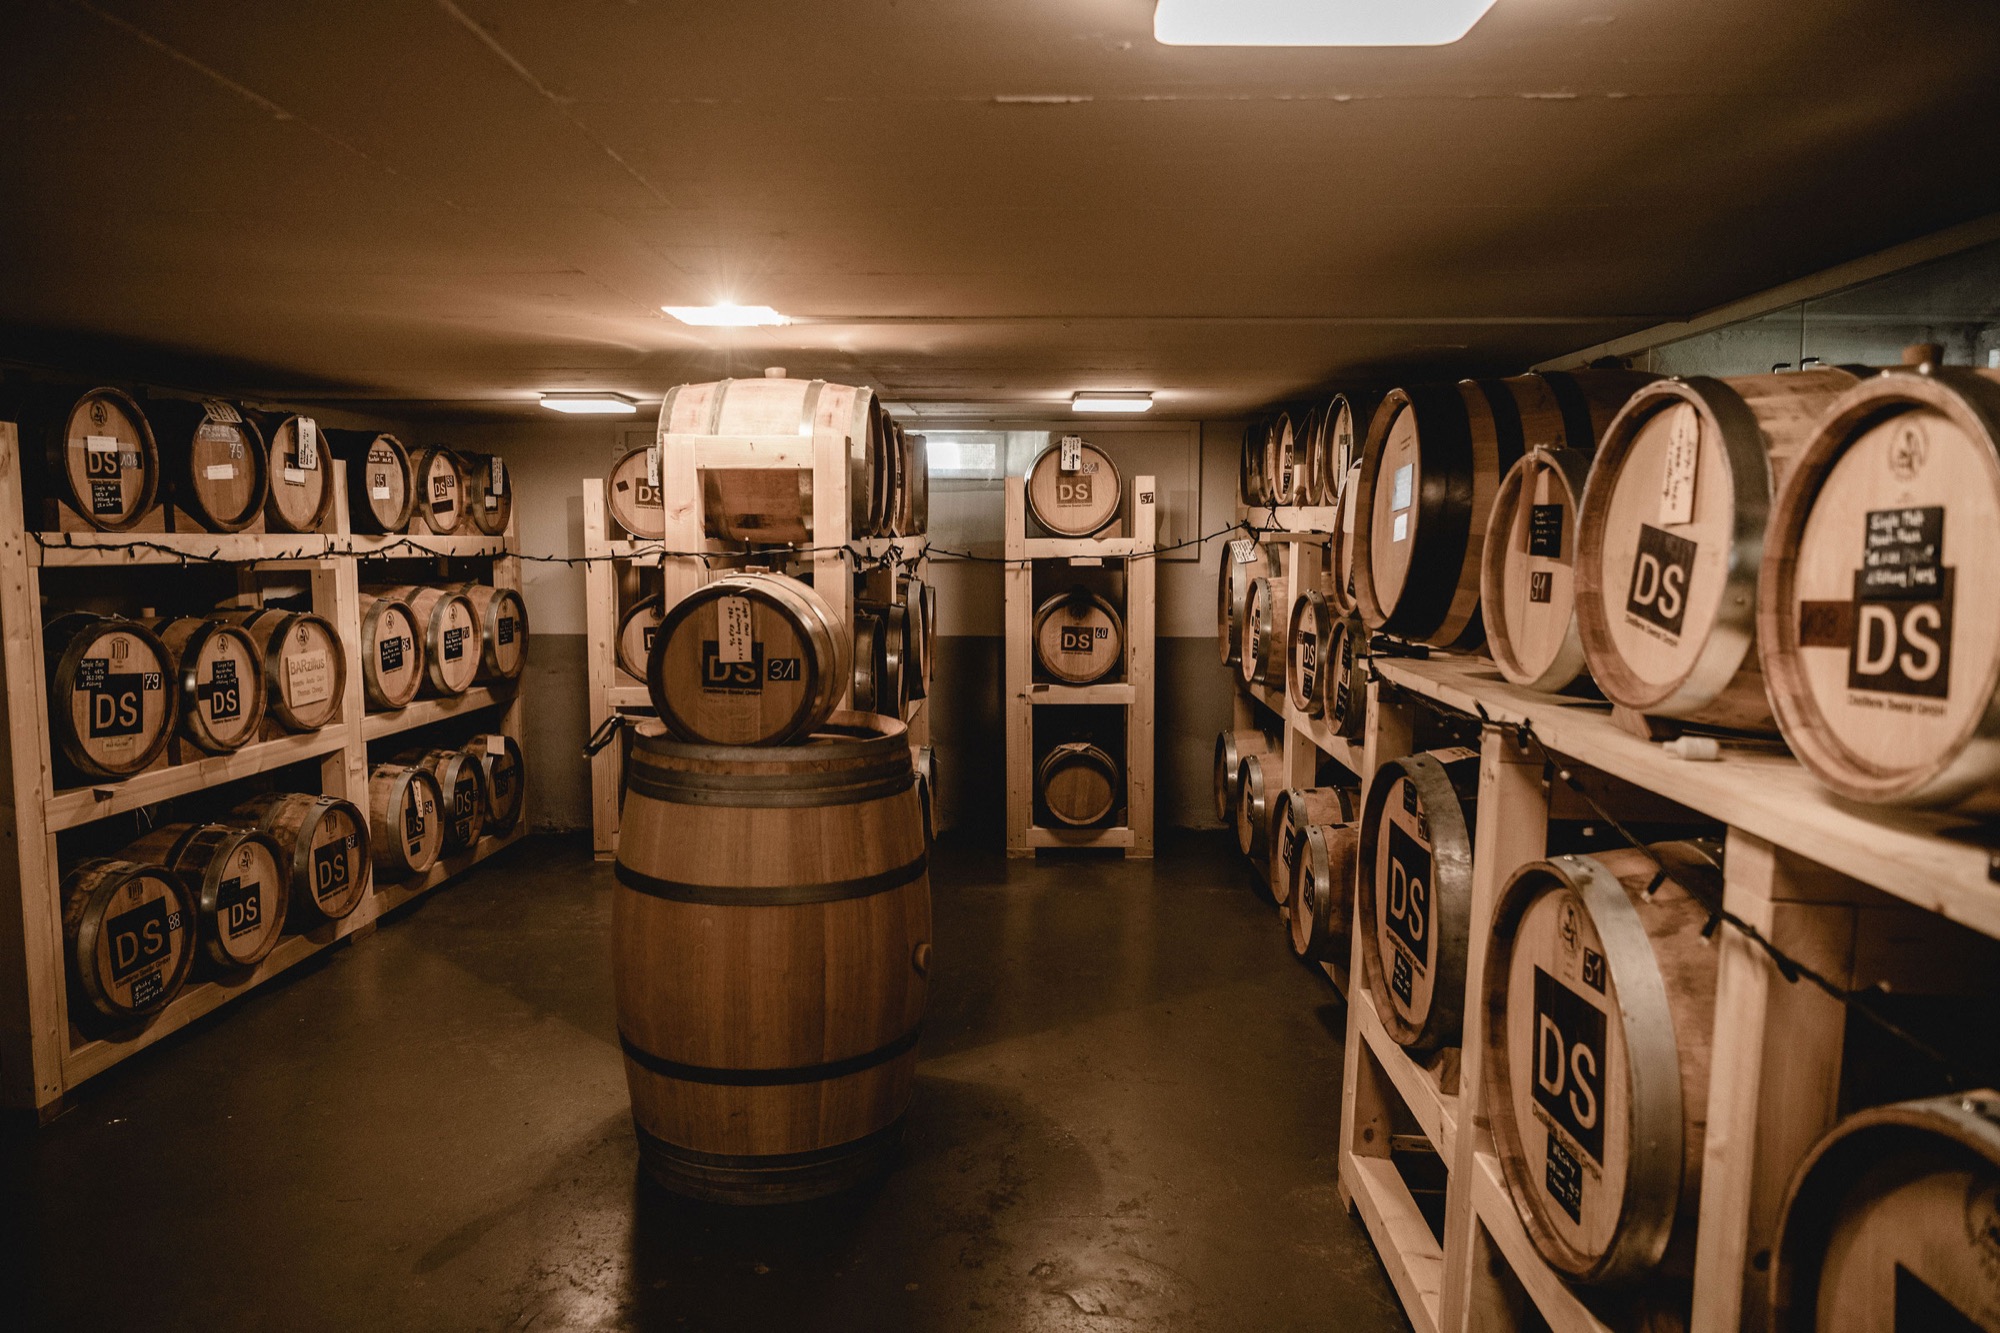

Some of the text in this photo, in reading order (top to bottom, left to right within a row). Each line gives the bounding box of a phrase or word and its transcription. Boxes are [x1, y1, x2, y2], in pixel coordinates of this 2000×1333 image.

[89, 452, 117, 474] DS
[230, 443, 242, 459] 75
[435, 482, 446, 495] DS
[1060, 484, 1088, 500] DS
[1141, 494, 1152, 504] 57
[1633, 552, 1684, 619] DS
[1064, 634, 1090, 649] DS
[1096, 628, 1106, 638] 60
[1856, 603, 1942, 681] DS
[1304, 642, 1315, 666] DS
[144, 674, 160, 690] 79
[709, 656, 756, 684] DS
[770, 659, 794, 680] 31
[96, 691, 138, 729] DS
[213, 689, 237, 714] DS
[457, 791, 471, 816] DS
[319, 854, 344, 889] DS
[1391, 856, 1424, 941] DS
[169, 913, 180, 930] 88
[232, 896, 257, 927] DS
[116, 919, 163, 969] DS
[1585, 950, 1601, 987] 51
[1539, 1012, 1597, 1130] DS
